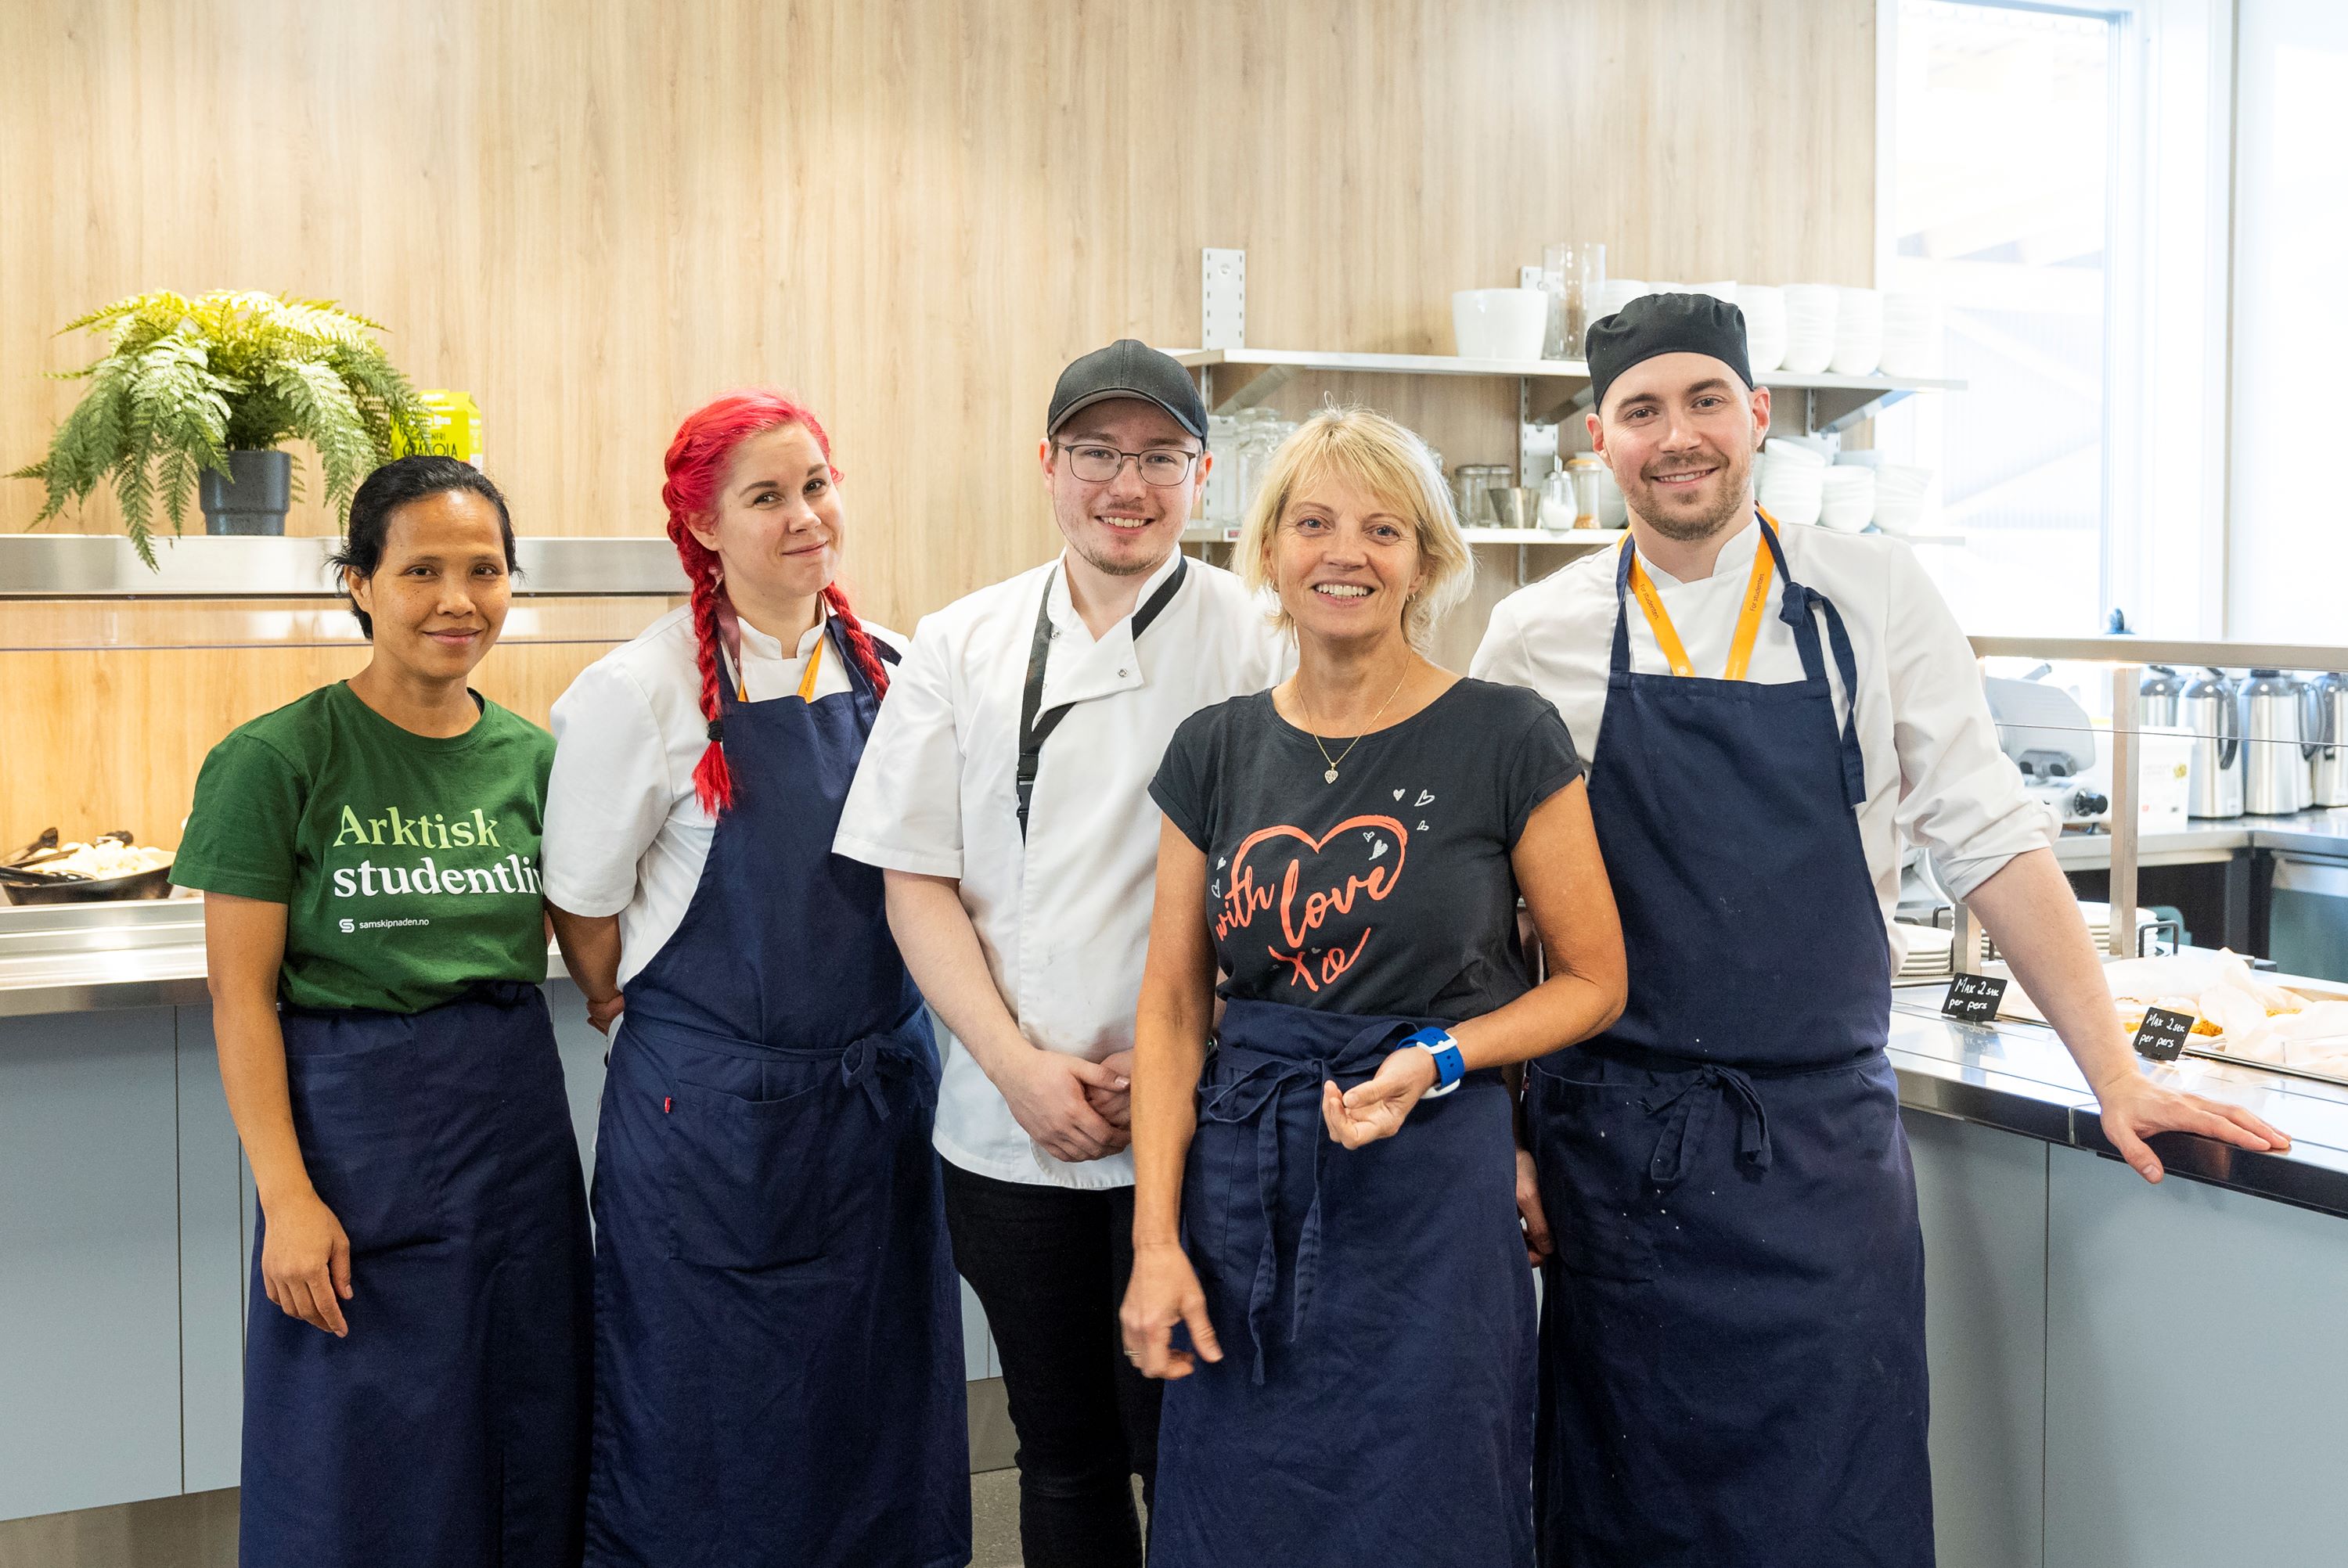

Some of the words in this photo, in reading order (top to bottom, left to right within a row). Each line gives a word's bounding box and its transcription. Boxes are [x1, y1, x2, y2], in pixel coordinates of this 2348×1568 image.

[333, 804, 501, 850] Arktisk
[1216, 865, 1275, 942] with
[1280, 858, 1387, 948] love
[358, 917, 430, 930] samskipnaden.no
[1948, 998, 1964, 1009] per
[1967, 1001, 1988, 1012] pers
[2138, 1034, 2154, 1045] per
[2155, 1037, 2174, 1048] pers
